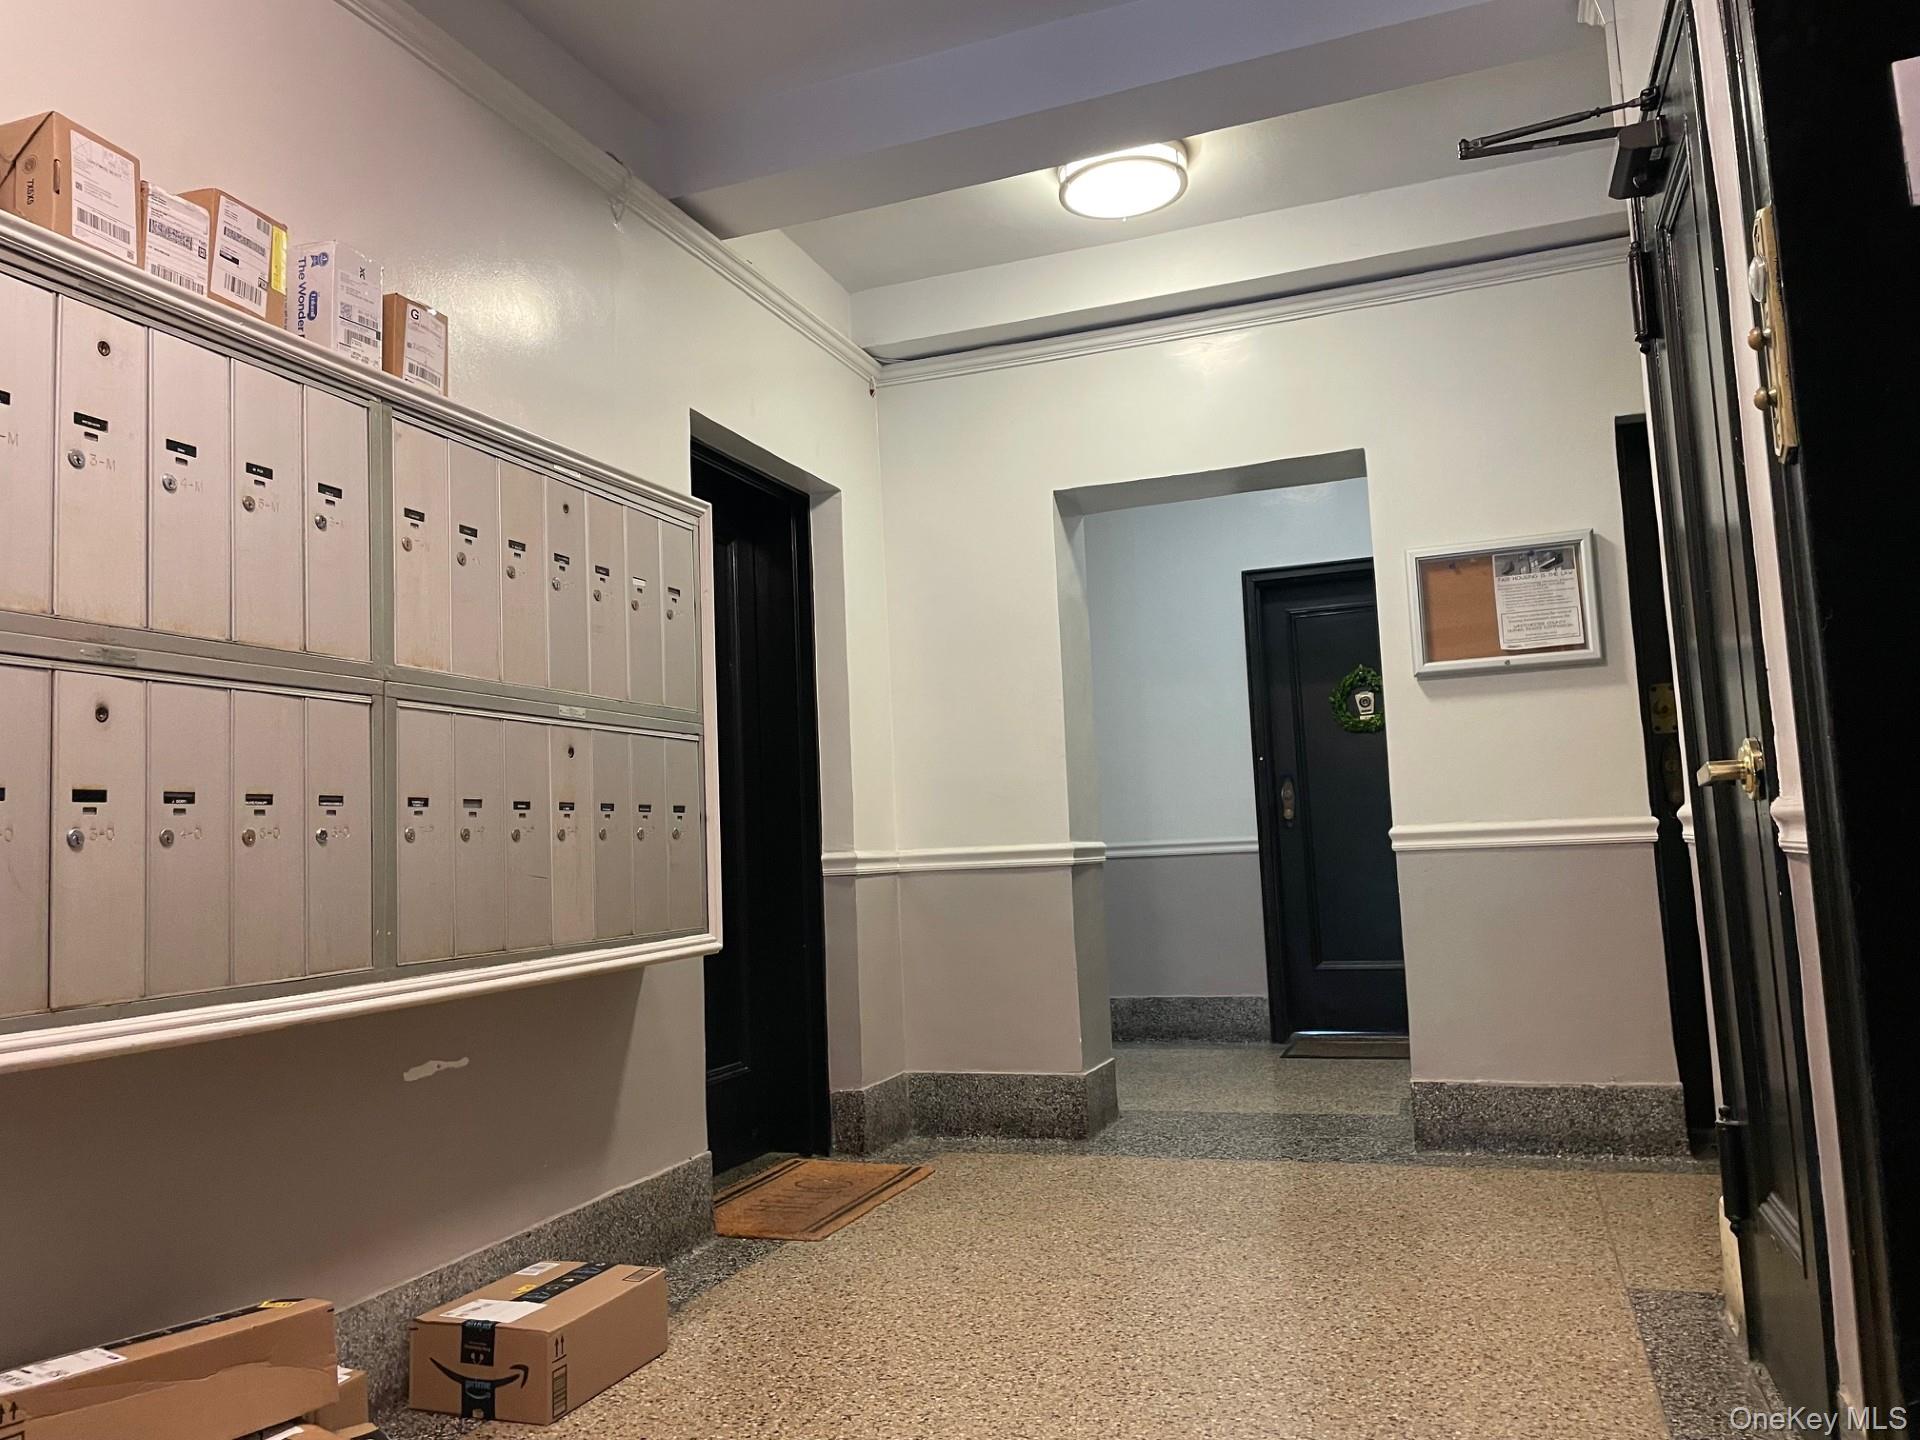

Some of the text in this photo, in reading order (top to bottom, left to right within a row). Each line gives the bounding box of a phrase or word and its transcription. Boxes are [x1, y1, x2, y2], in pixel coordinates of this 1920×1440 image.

[298, 256, 307, 280] The
[297, 281, 308, 333] Wonder
[410, 309, 420, 320] G
[89, 452, 116, 473] 3-M
